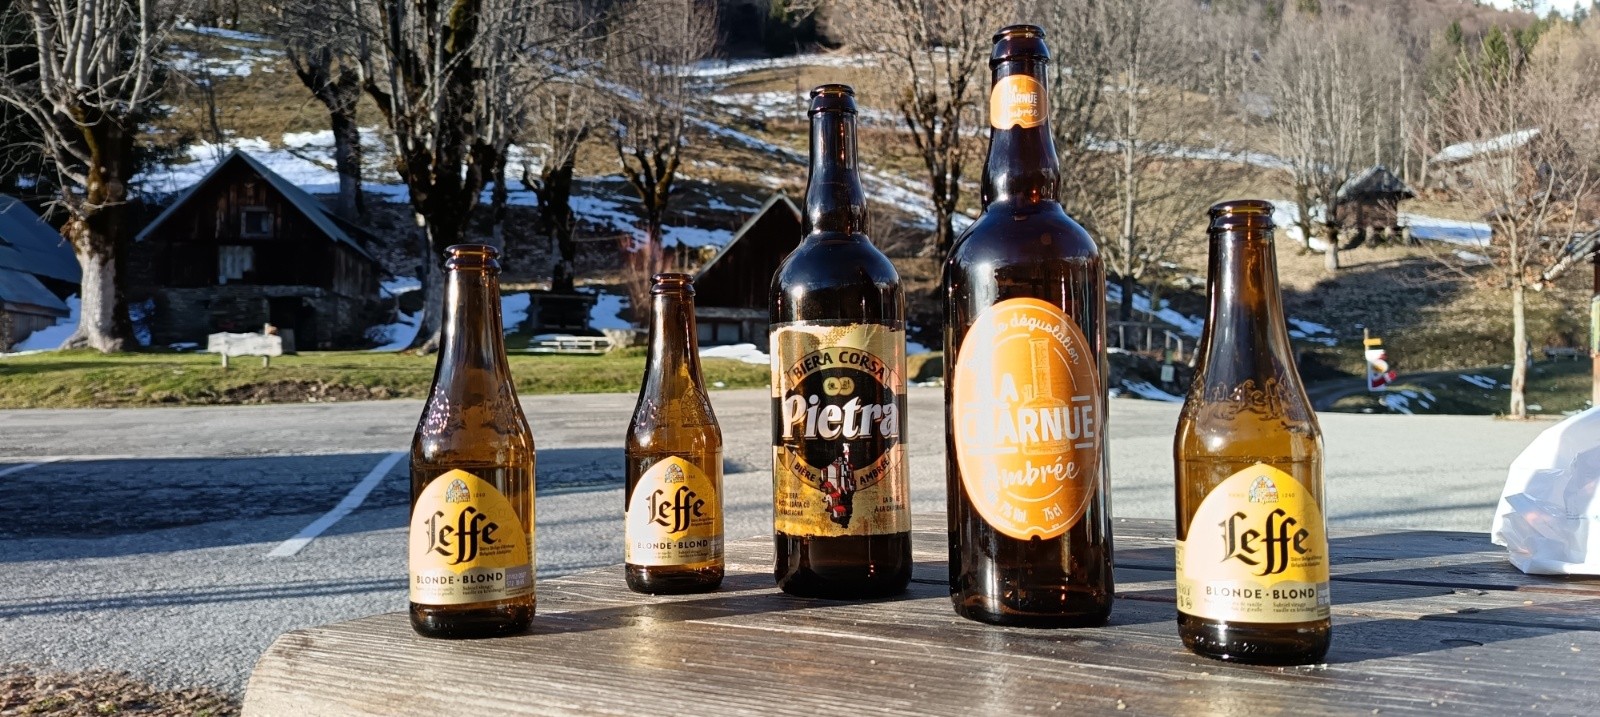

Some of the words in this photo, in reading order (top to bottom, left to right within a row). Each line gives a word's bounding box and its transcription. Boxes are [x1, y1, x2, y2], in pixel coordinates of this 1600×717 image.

[1001, 93, 1038, 105] ARNUE
[1010, 312, 1079, 365] dégustation
[793, 352, 833, 380] BIERA
[838, 351, 885, 380] CORSA
[782, 394, 899, 440] Pietra
[794, 462, 816, 482] BIÈRE
[860, 458, 889, 485] AMBRÉE
[984, 456, 1080, 491] Ambrée
[645, 486, 705, 534] Leffe
[424, 506, 499, 565] Leffe
[678, 540, 708, 549] BLOND
[1218, 508, 1310, 577] Leffe
[416, 575, 454, 585] BLONDE
[462, 572, 503, 584] BLOND
[1206, 586, 1262, 599] BLONDE
[1273, 588, 1315, 600] BLOND
